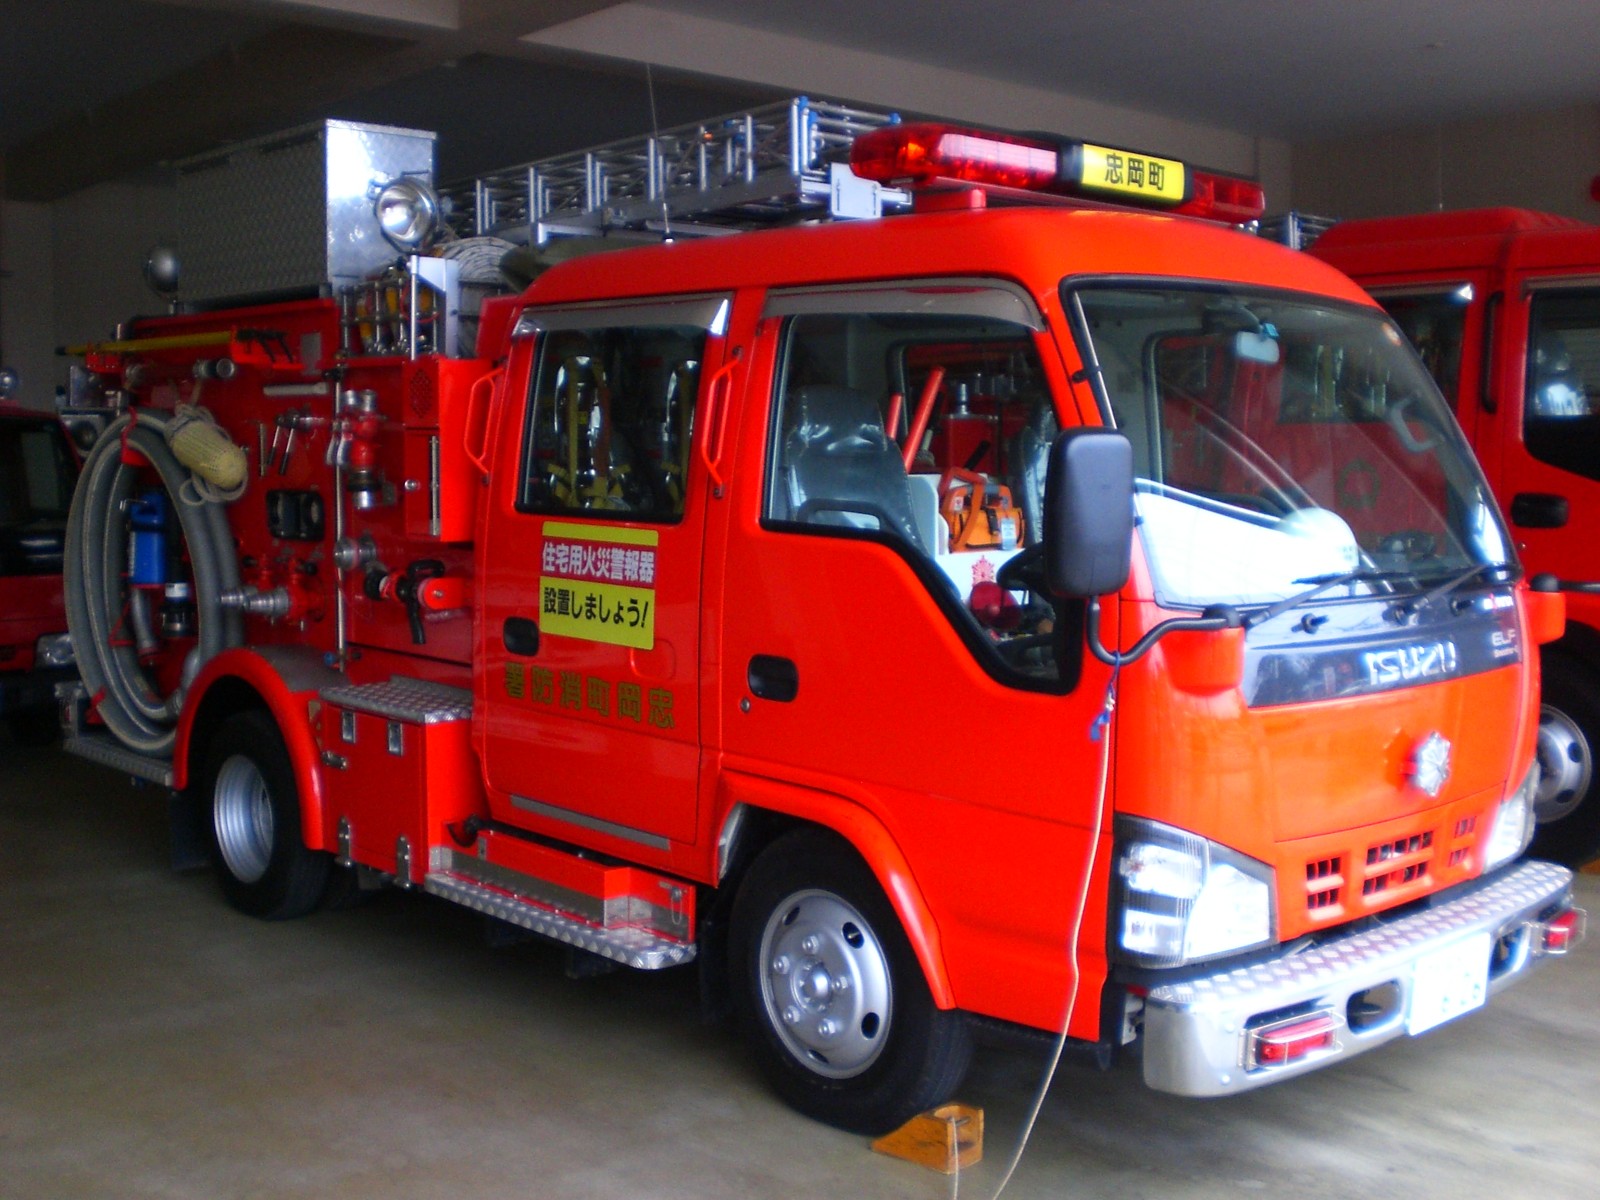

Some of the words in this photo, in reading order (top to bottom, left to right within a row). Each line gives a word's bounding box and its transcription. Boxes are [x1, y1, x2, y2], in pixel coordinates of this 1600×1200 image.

[1105, 153, 1165, 191] 忠岡町
[542, 542, 655, 583] 住宅用火災警報器
[1365, 641, 1457, 686] ISUZU
